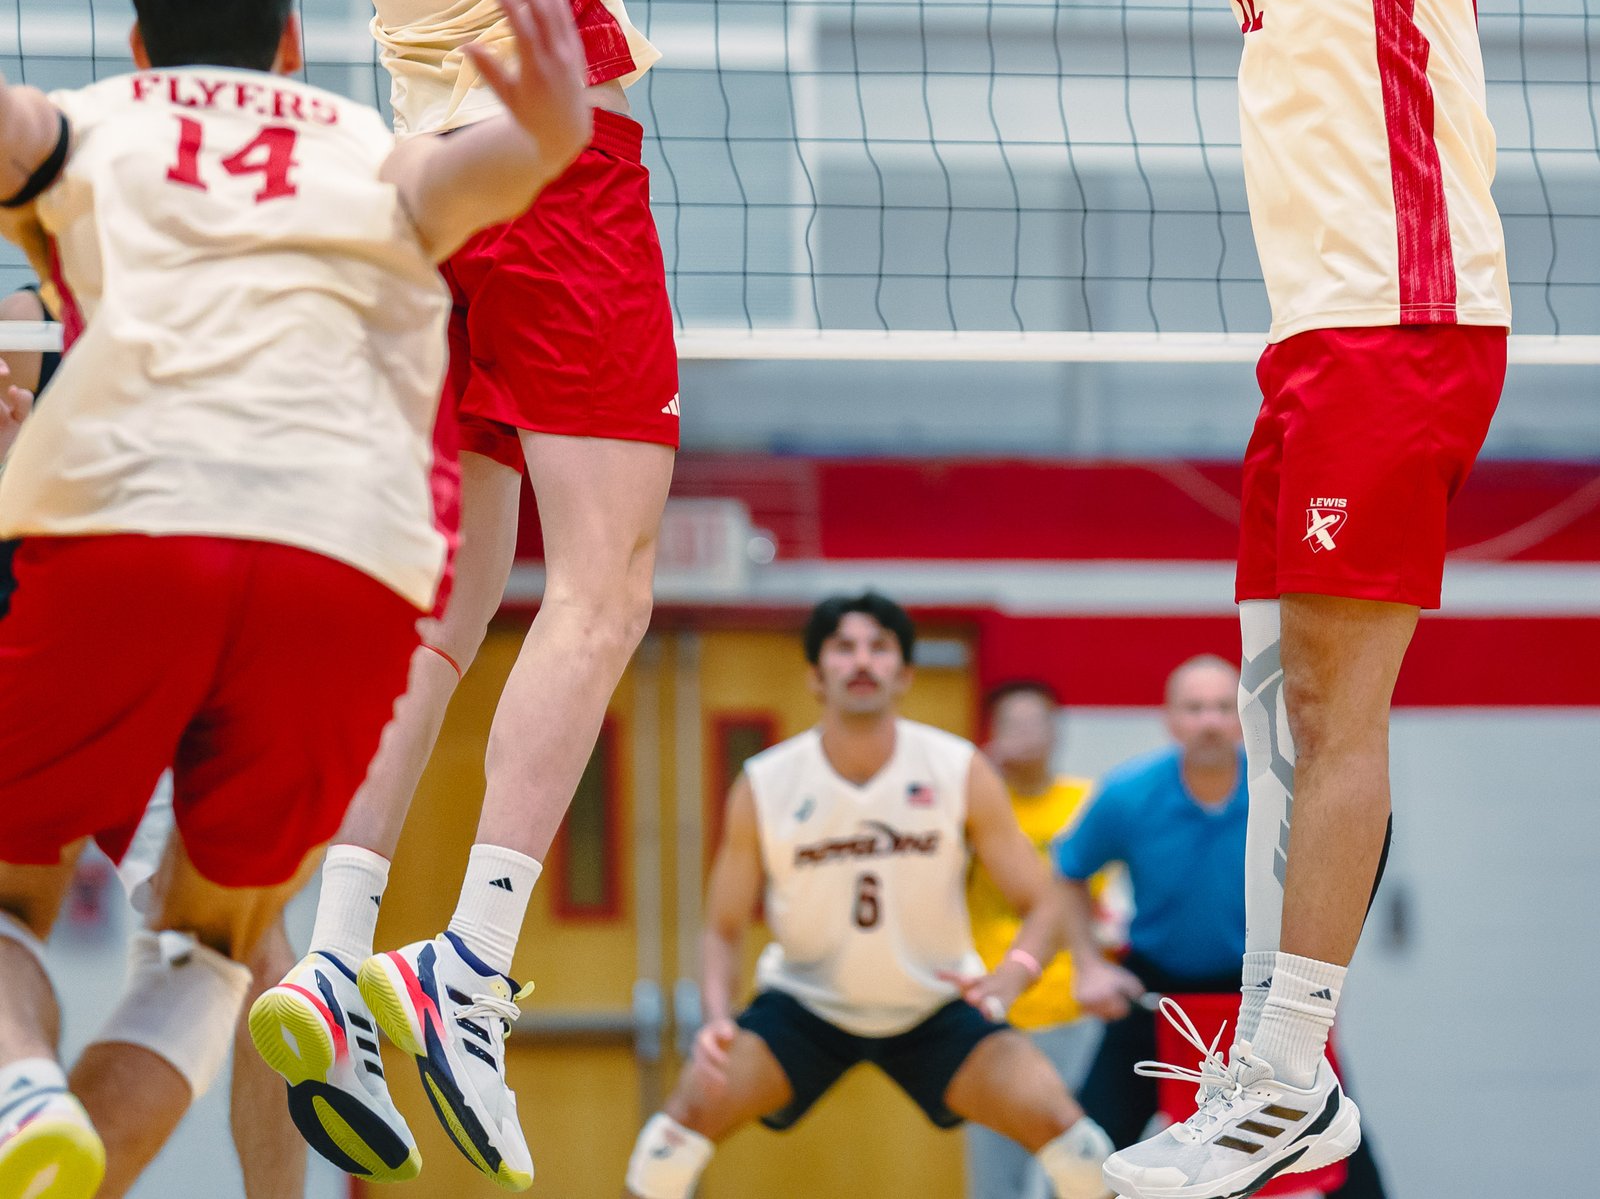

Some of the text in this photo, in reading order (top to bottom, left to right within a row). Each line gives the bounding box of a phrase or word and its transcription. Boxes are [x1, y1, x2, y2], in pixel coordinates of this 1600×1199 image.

[131, 74, 338, 125] FLYERS
[166, 114, 299, 204] 14
[1310, 498, 1347, 508] LEWIS
[855, 872, 881, 930] 6
